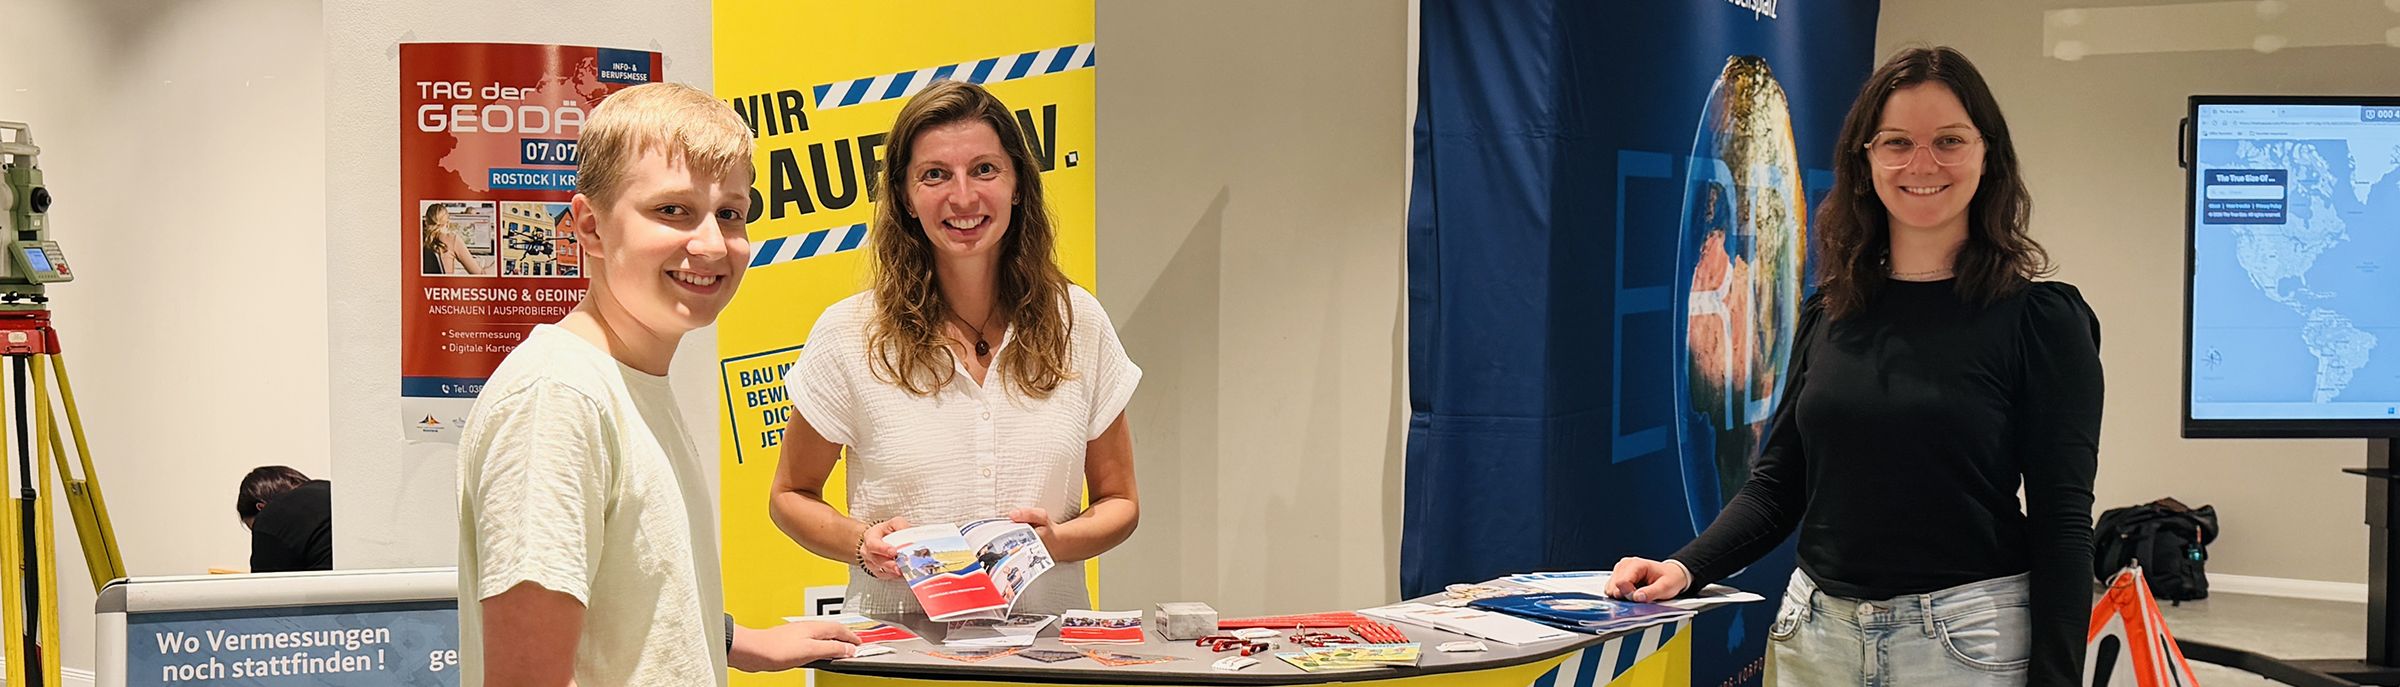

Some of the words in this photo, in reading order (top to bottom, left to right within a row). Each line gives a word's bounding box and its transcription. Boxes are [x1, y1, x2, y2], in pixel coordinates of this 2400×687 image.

[612, 63, 631, 71] INFO-
[631, 64, 637, 72] &
[601, 70, 648, 82] BERUFSMESSE
[416, 81, 473, 100] TAG
[481, 82, 536, 101] der
[417, 100, 586, 134] GEODÄ
[492, 173, 550, 185] ROSTOCK
[424, 287, 518, 301] VERMESSUNG
[521, 288, 532, 302] &
[428, 305, 486, 315] ANSCHAUEN
[493, 306, 566, 316] AUSPROBIEREN
[448, 330, 521, 341] Seevermessung
[449, 343, 484, 354] Digitale
[739, 366, 774, 388] BAU
[453, 384, 467, 394] Tel.
[763, 404, 794, 427] DIC
[156, 632, 200, 655] Wo
[206, 627, 391, 651] Vermessungen
[162, 657, 225, 682] noch
[232, 651, 371, 679] stattfinden
[378, 649, 386, 671] !
